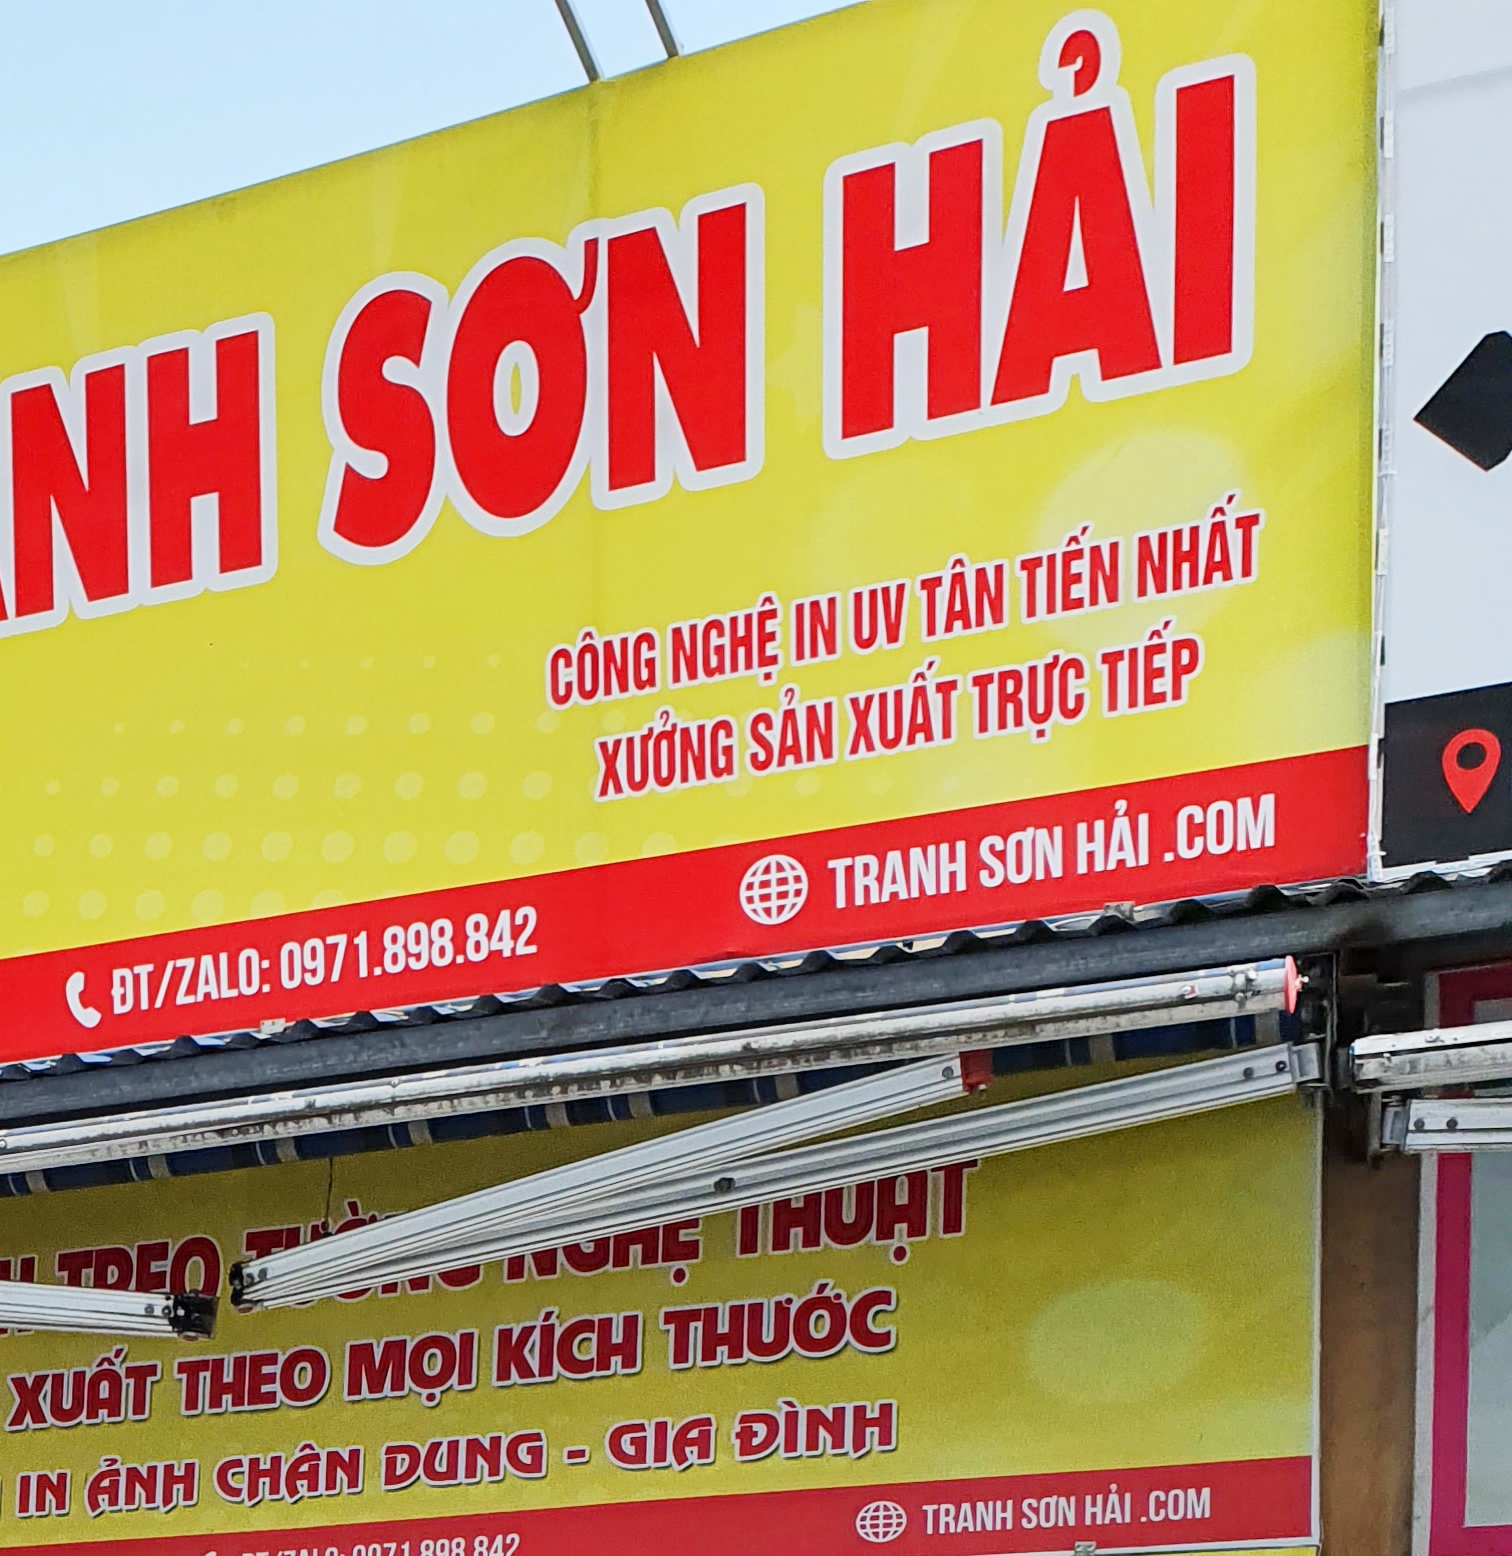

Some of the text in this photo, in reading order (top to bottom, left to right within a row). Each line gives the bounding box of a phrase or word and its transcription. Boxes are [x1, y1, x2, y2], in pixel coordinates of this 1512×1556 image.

[333, 200, 748, 548] SƠN
[842, 32, 1235, 446] HẢI
[548, 492, 1260, 707] CÔNG NGHỆ IN UV TÂN TIẾN NHẤT
[596, 619, 1200, 798] XƯỞNG SẢN XUẤT TRỰC TIẾP
[828, 794, 1274, 907] TRANH SƠN HẢI .COM
[111, 906, 538, 1015] ĐT/ZALO: 0971.898.842
[8, 1347, 158, 1429] XUẤT
[177, 1346, 327, 1416] THEO
[344, 1331, 476, 1405] MỌI
[495, 1310, 641, 1385] KÍCH
[661, 1281, 896, 1369] THƯỚC
[17, 1471, 69, 1515] IN
[87, 1457, 198, 1514] ẢNH
[214, 1442, 362, 1505] CHÂN
[383, 1433, 544, 1488] DUNG
[607, 1417, 715, 1469] GIA
[735, 1400, 896, 1458] ĐÌNH
[922, 1483, 1211, 1535] TRANH SƠN HẢI .COM
